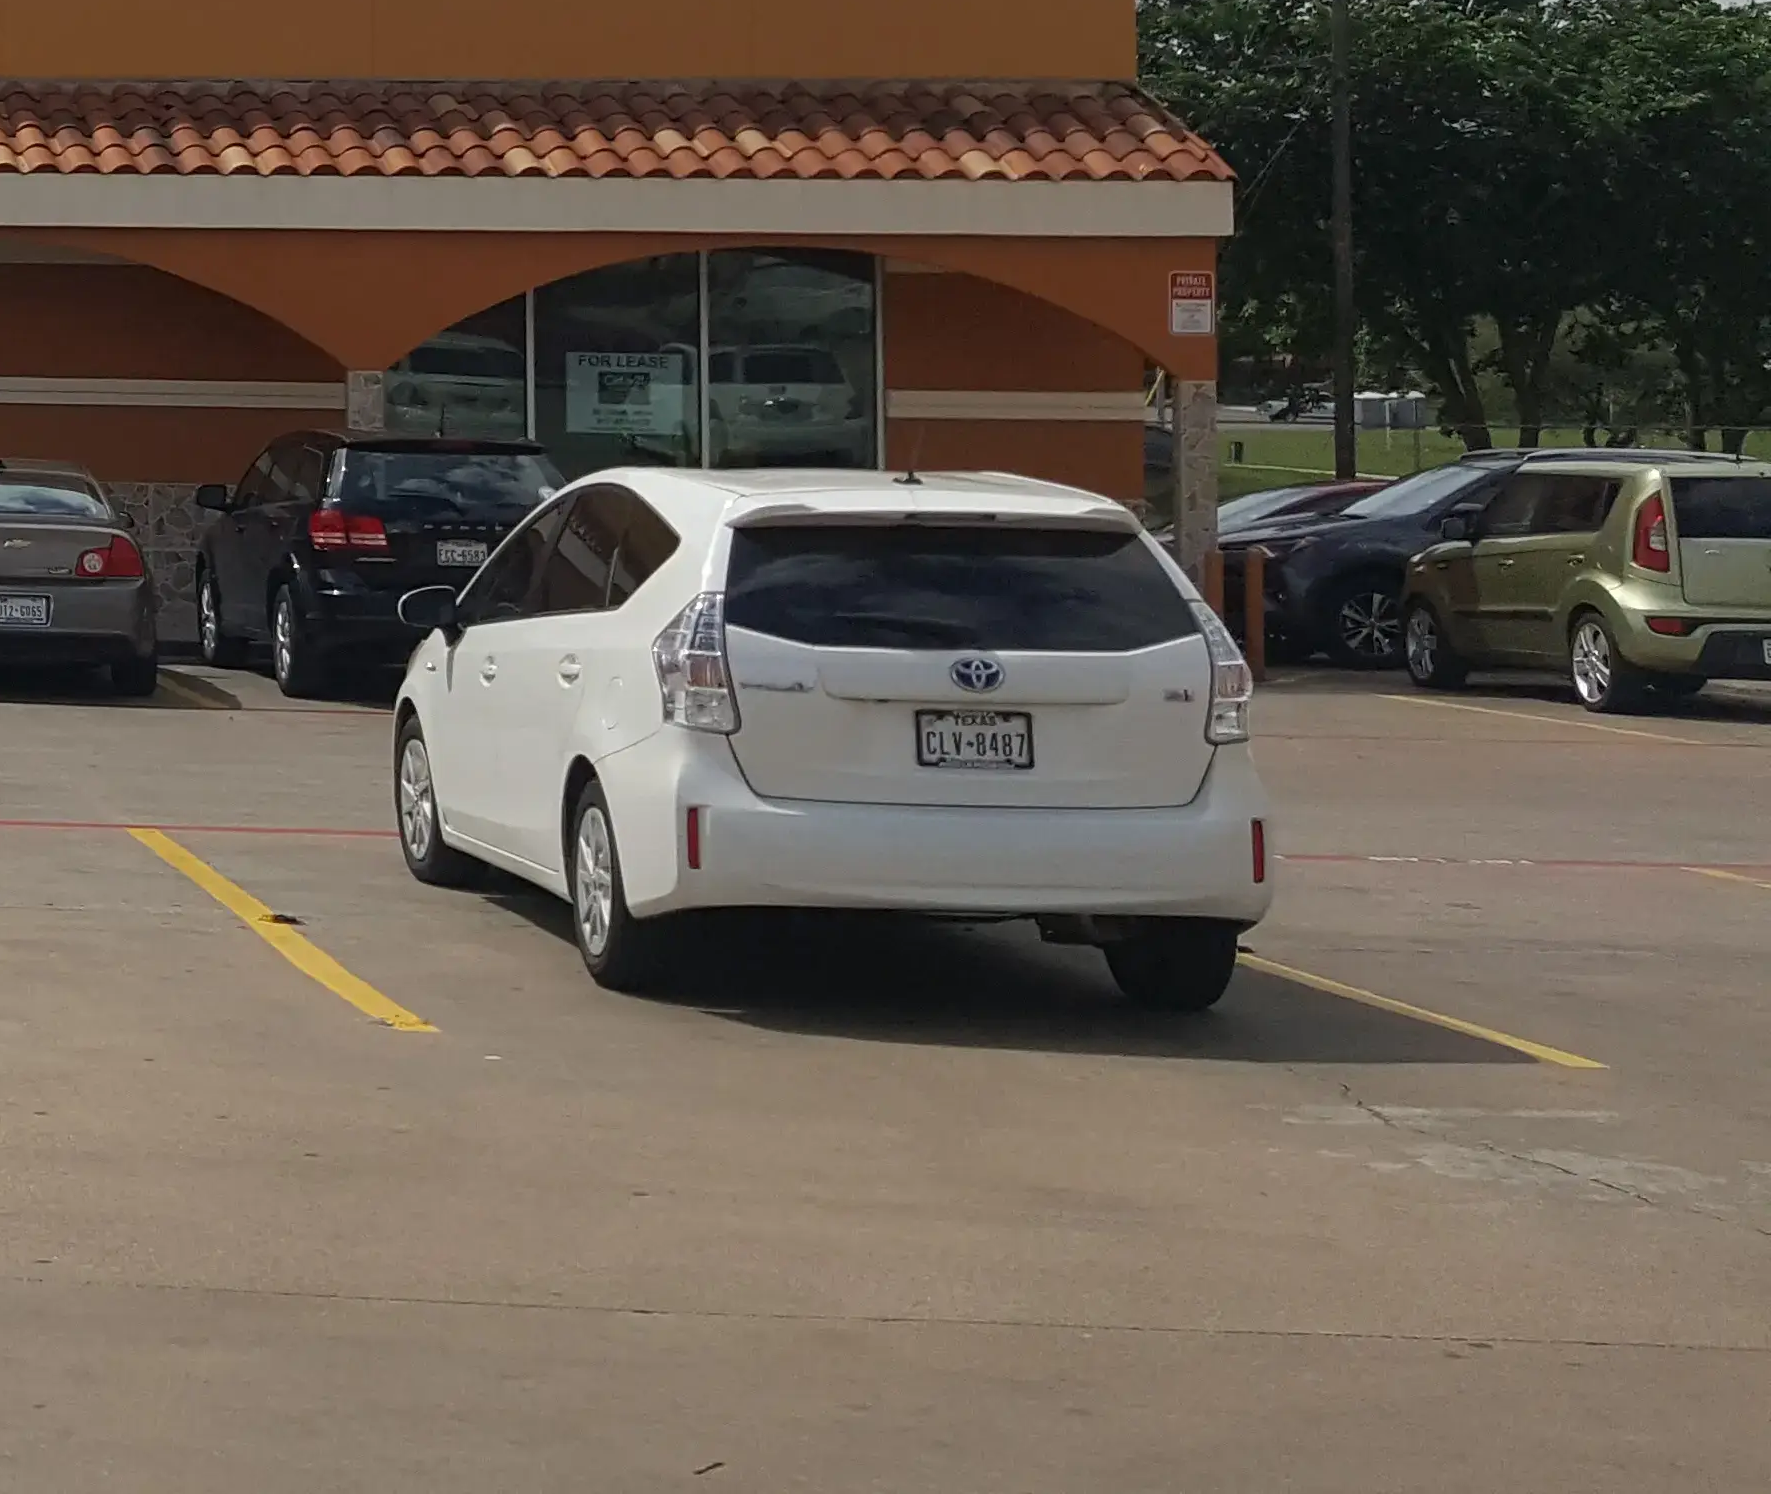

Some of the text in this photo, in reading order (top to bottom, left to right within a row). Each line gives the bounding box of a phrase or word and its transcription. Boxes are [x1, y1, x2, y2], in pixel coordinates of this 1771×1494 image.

[578, 354, 669, 369] FOR LEASE
[953, 714, 997, 726] TEXAS
